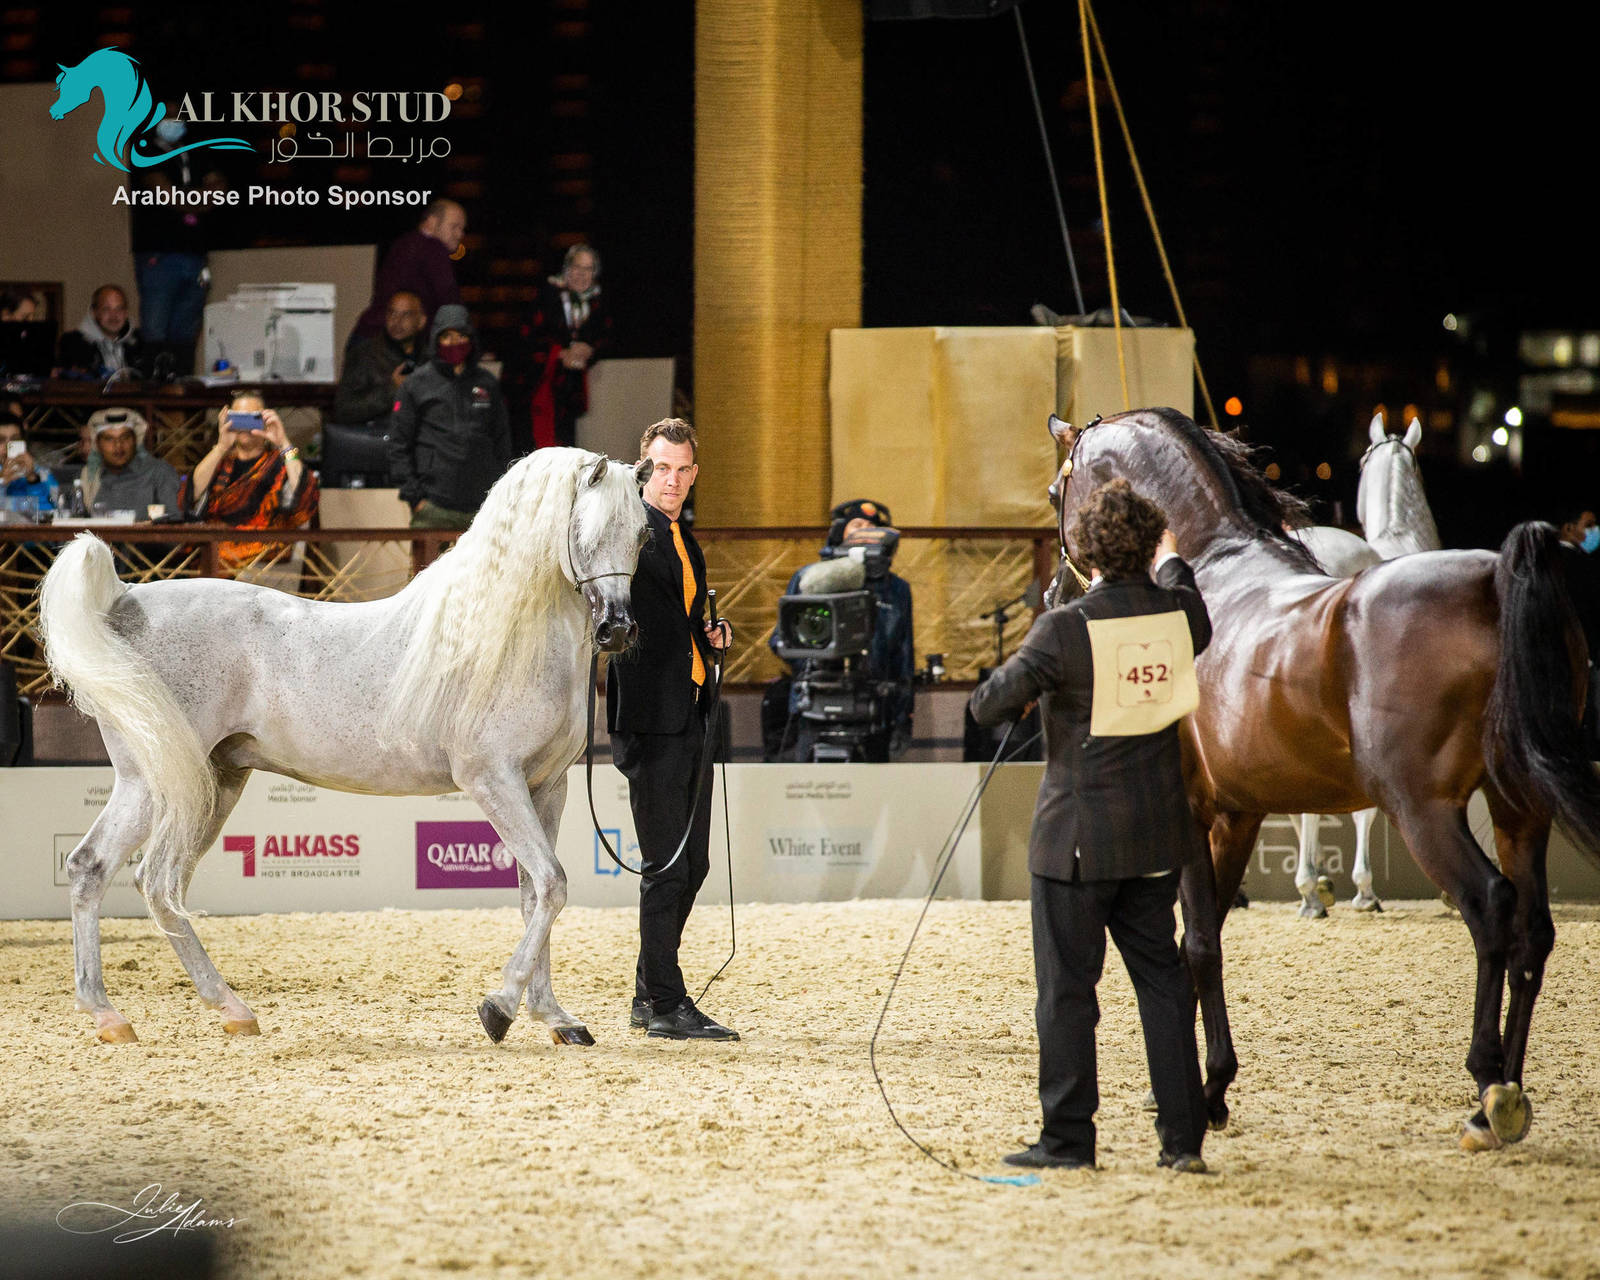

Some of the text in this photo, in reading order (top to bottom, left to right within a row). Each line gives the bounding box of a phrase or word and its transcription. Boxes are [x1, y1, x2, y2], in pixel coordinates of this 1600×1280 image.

[1125, 664, 1169, 685] 452
[262, 834, 360, 857] ALKASS
[427, 842, 491, 869] QATAR
[769, 838, 862, 857] White Event
[261, 869, 360, 878] HOST BROADCASTER
